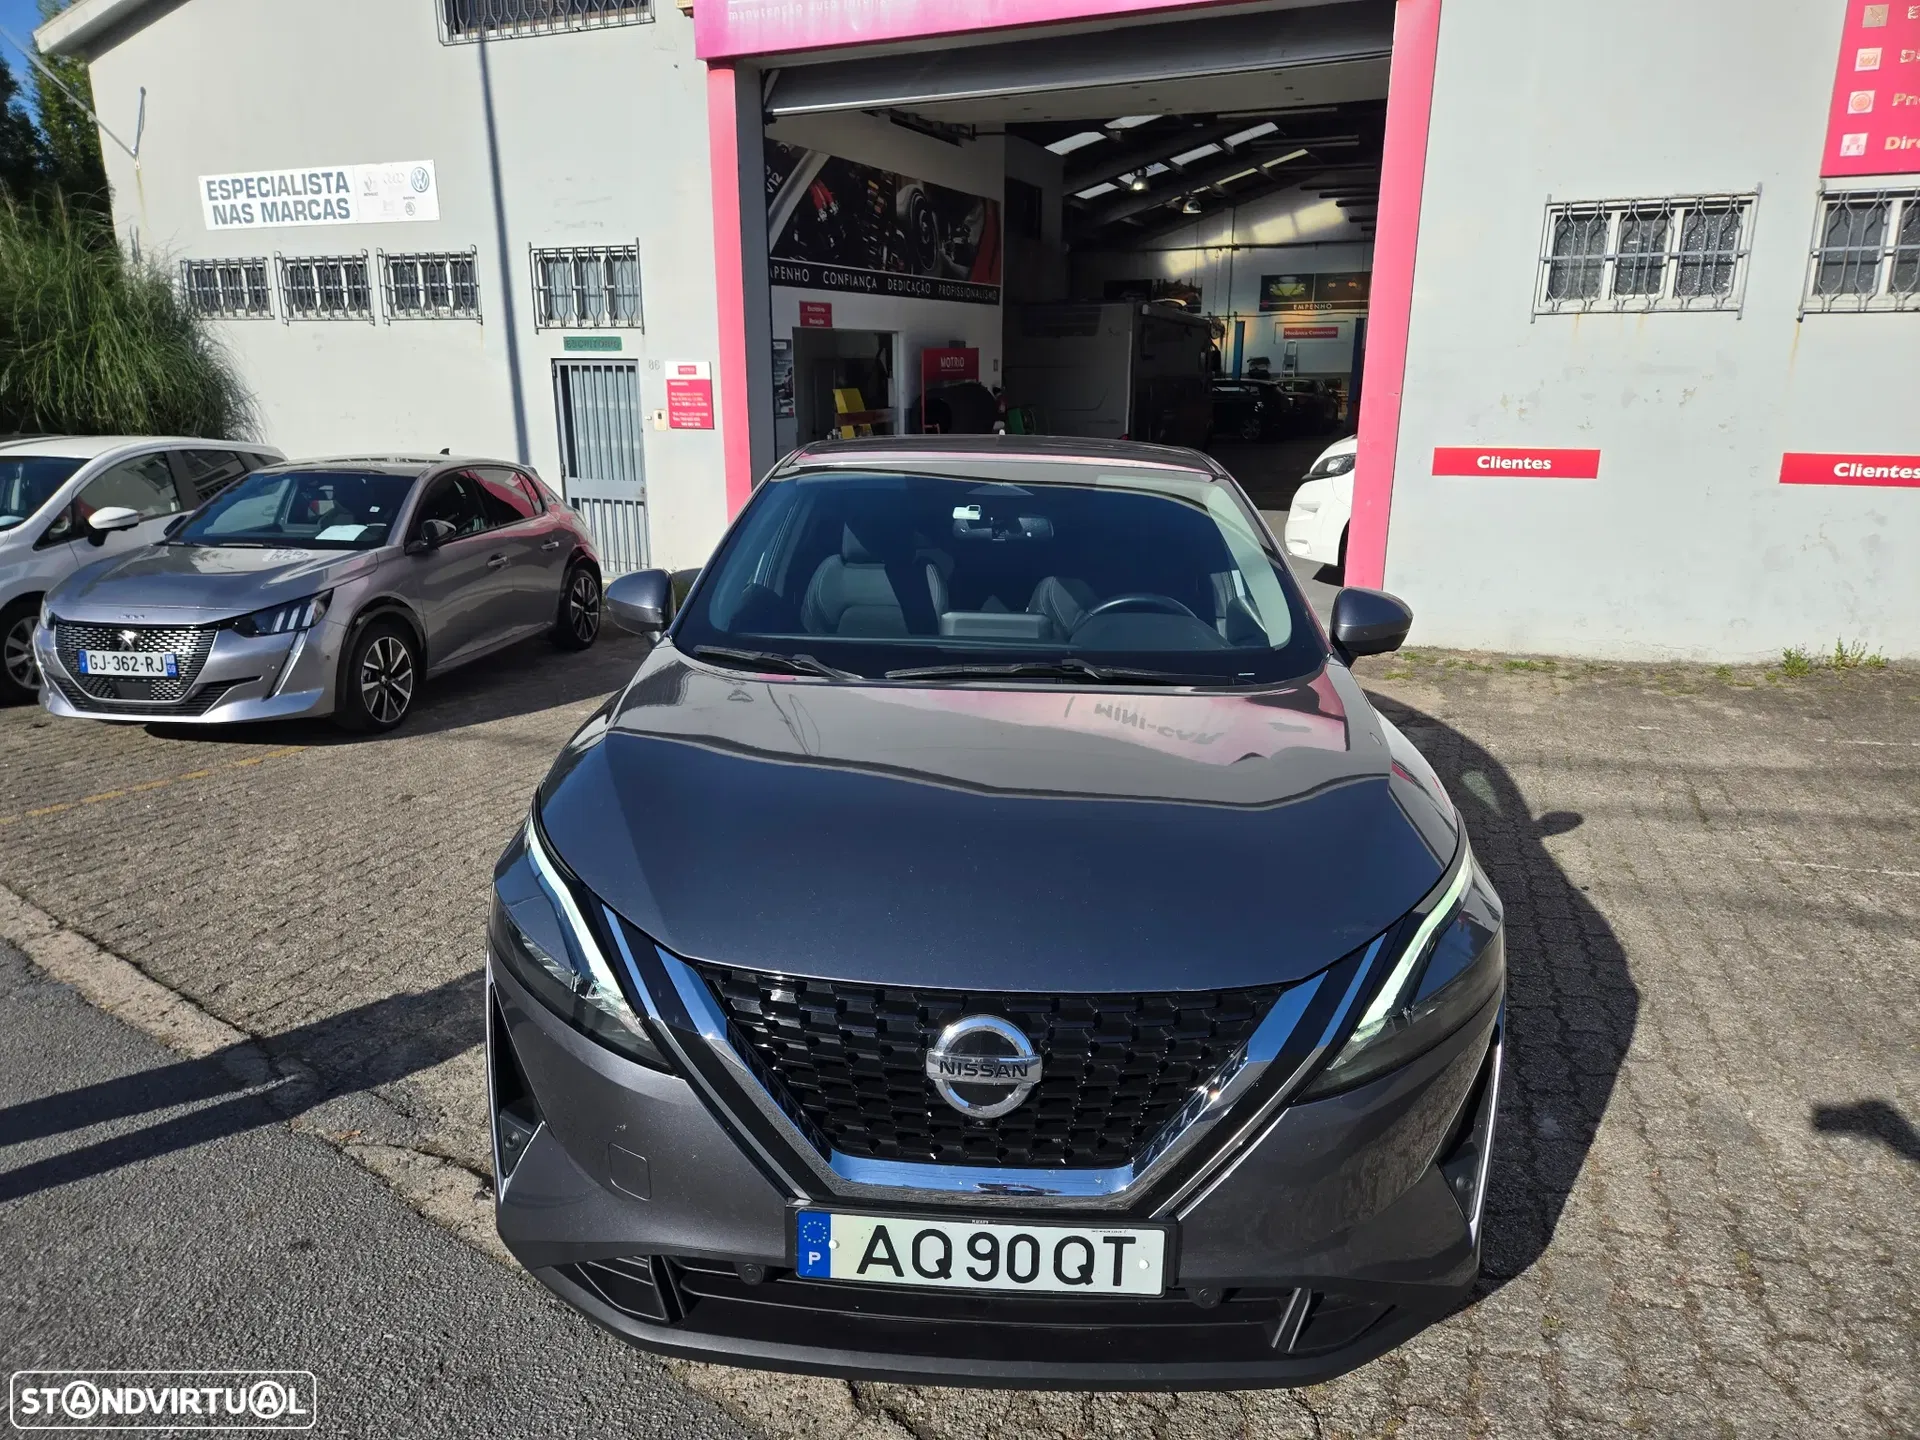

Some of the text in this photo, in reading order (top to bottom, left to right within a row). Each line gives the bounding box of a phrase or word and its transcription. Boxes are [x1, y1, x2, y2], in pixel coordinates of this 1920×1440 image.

[206, 171, 350, 201] ESPECIALISTA
[212, 197, 351, 225] NAS MARCAS
[822, 270, 877, 289] CONFIANÇA
[887, 278, 931, 296] DEDICAÇÃO
[1293, 303, 1333, 311] EMPENHO
[940, 356, 965, 369] MOTRIO
[1476, 455, 1552, 470] Clientes
[1832, 462, 1920, 480] Clientes
[89, 654, 164, 673] GJ-362-RJ
[939, 1060, 1028, 1078] NISSAN
[808, 1251, 821, 1265] P
